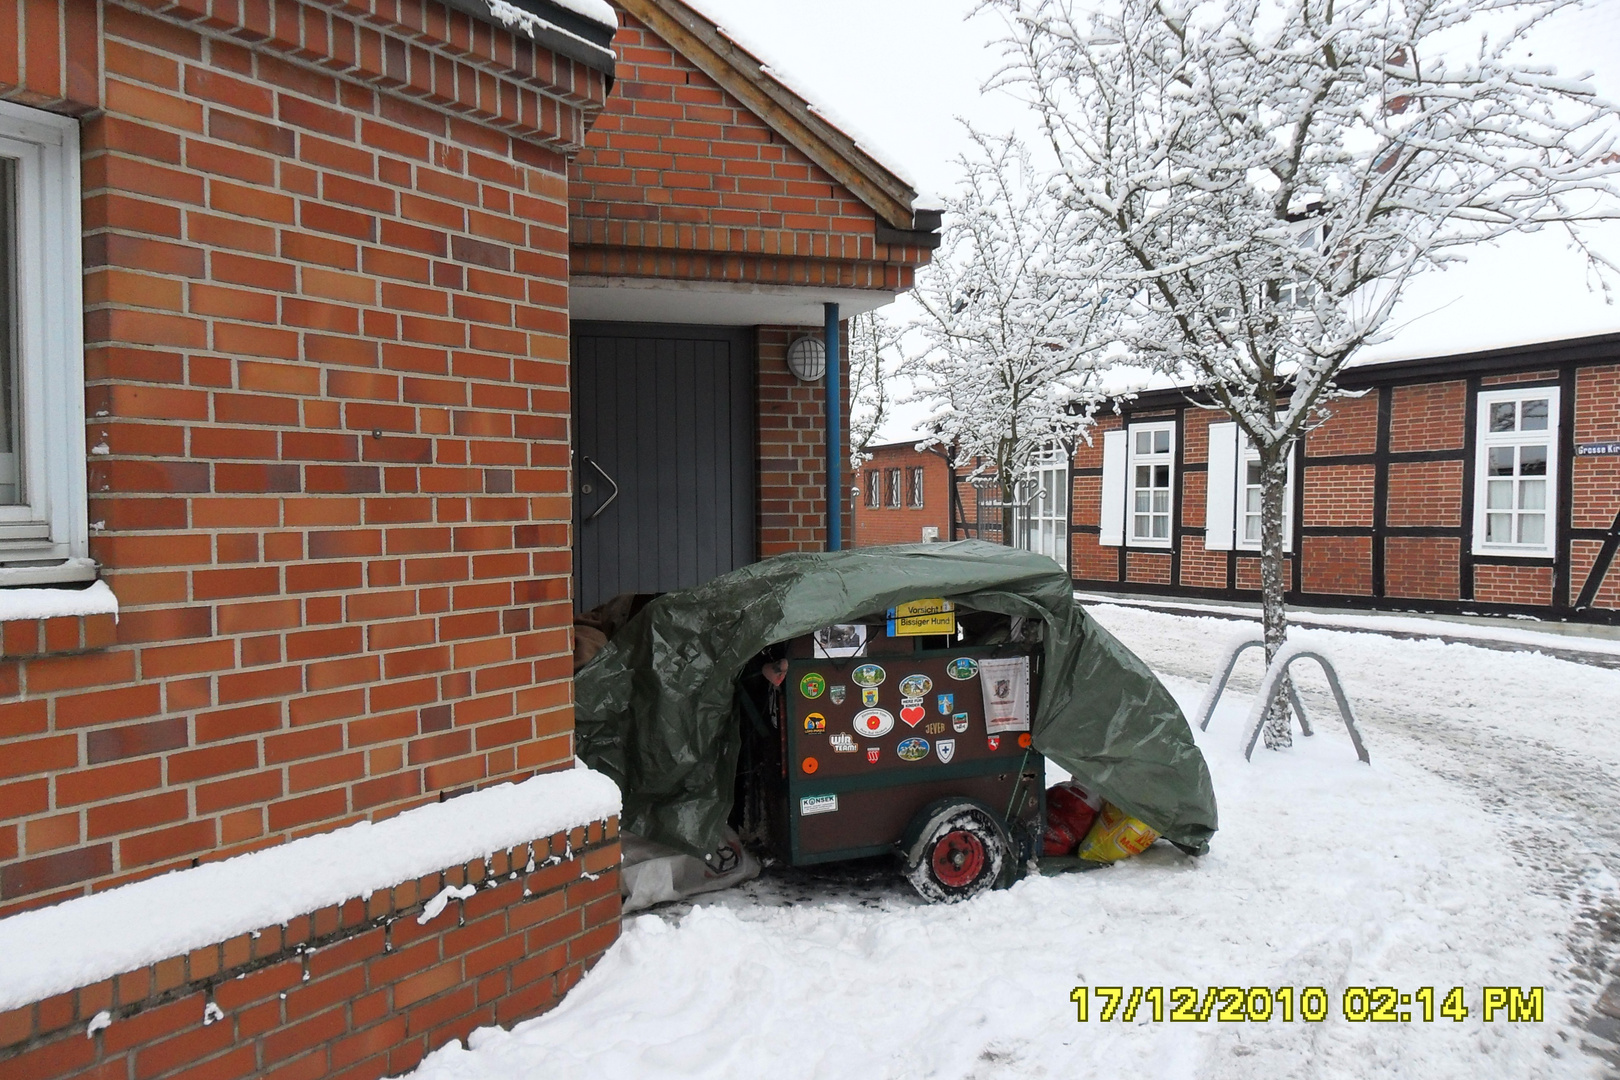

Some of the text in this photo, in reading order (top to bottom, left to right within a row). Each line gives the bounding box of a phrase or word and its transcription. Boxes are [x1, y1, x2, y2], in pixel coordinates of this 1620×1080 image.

[1578, 445, 1606, 455] Grosse
[907, 605, 939, 614] Vorsicht
[900, 617, 950, 627] Bissiger Hund
[925, 722, 946, 735] JEVER
